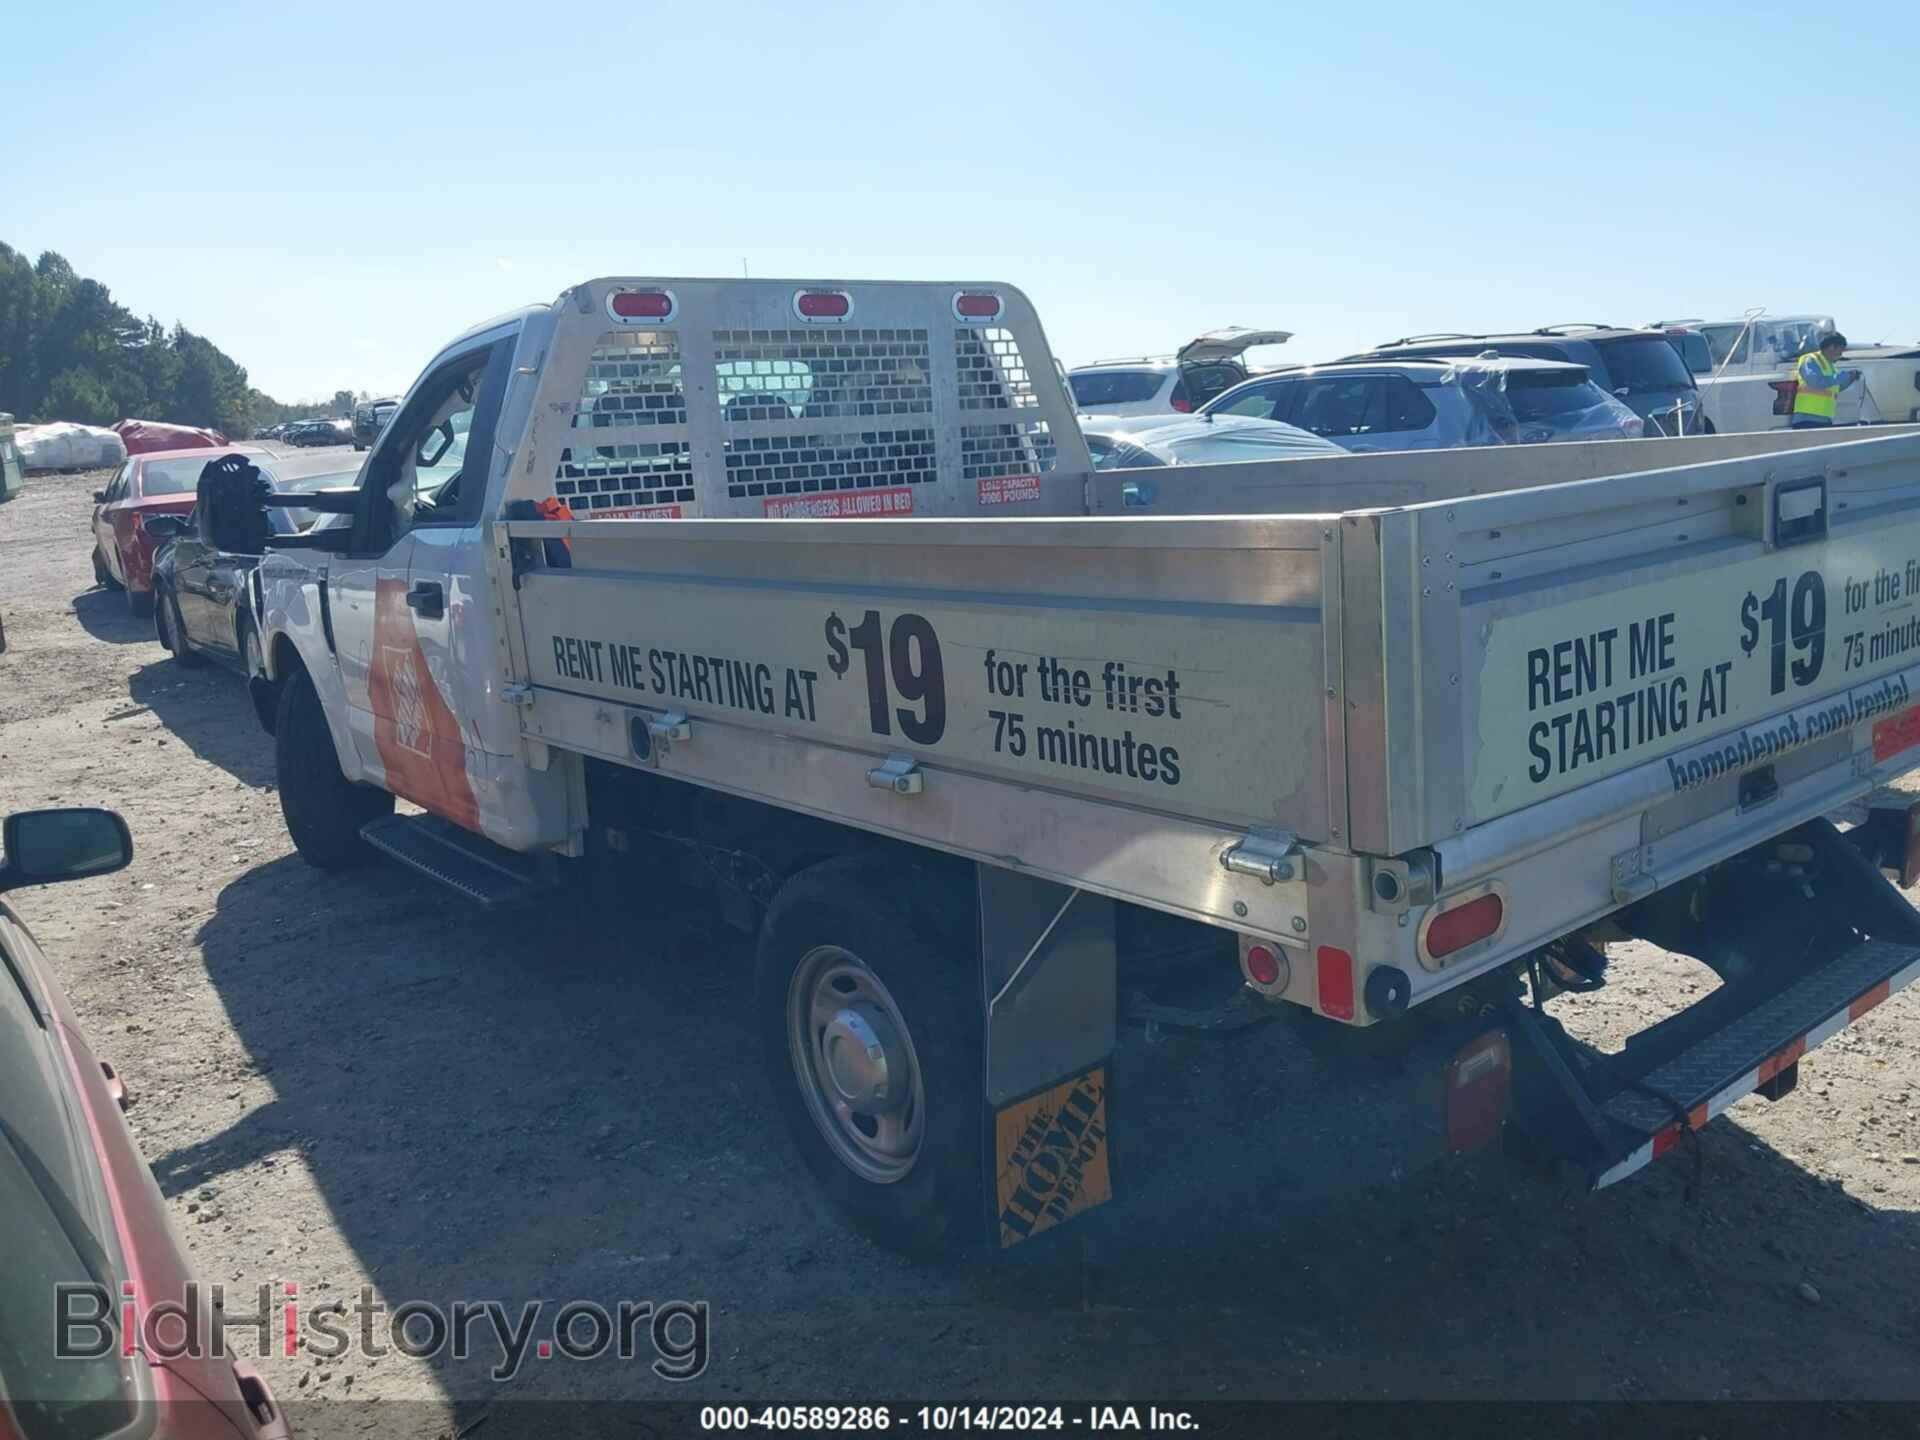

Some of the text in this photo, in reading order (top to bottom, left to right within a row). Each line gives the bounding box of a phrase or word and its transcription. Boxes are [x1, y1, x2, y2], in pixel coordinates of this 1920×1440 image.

[842, 494, 882, 515] ALLOWED
[883, 493, 893, 512] IN
[894, 491, 912, 510] BED
[1003, 487, 1040, 502] POUNDS
[1844, 575, 1870, 615] for
[1874, 567, 1900, 606] the
[552, 609, 946, 746] RENT ME STARTING AT $19
[984, 650, 1182, 720] for the first
[1528, 612, 1676, 711] RENT ME
[1528, 570, 1827, 784] STARTING AT $19
[1843, 630, 1865, 672] 75
[988, 710, 1181, 786] 75 minutes
[1666, 673, 1910, 792] homedepot.com/rental
